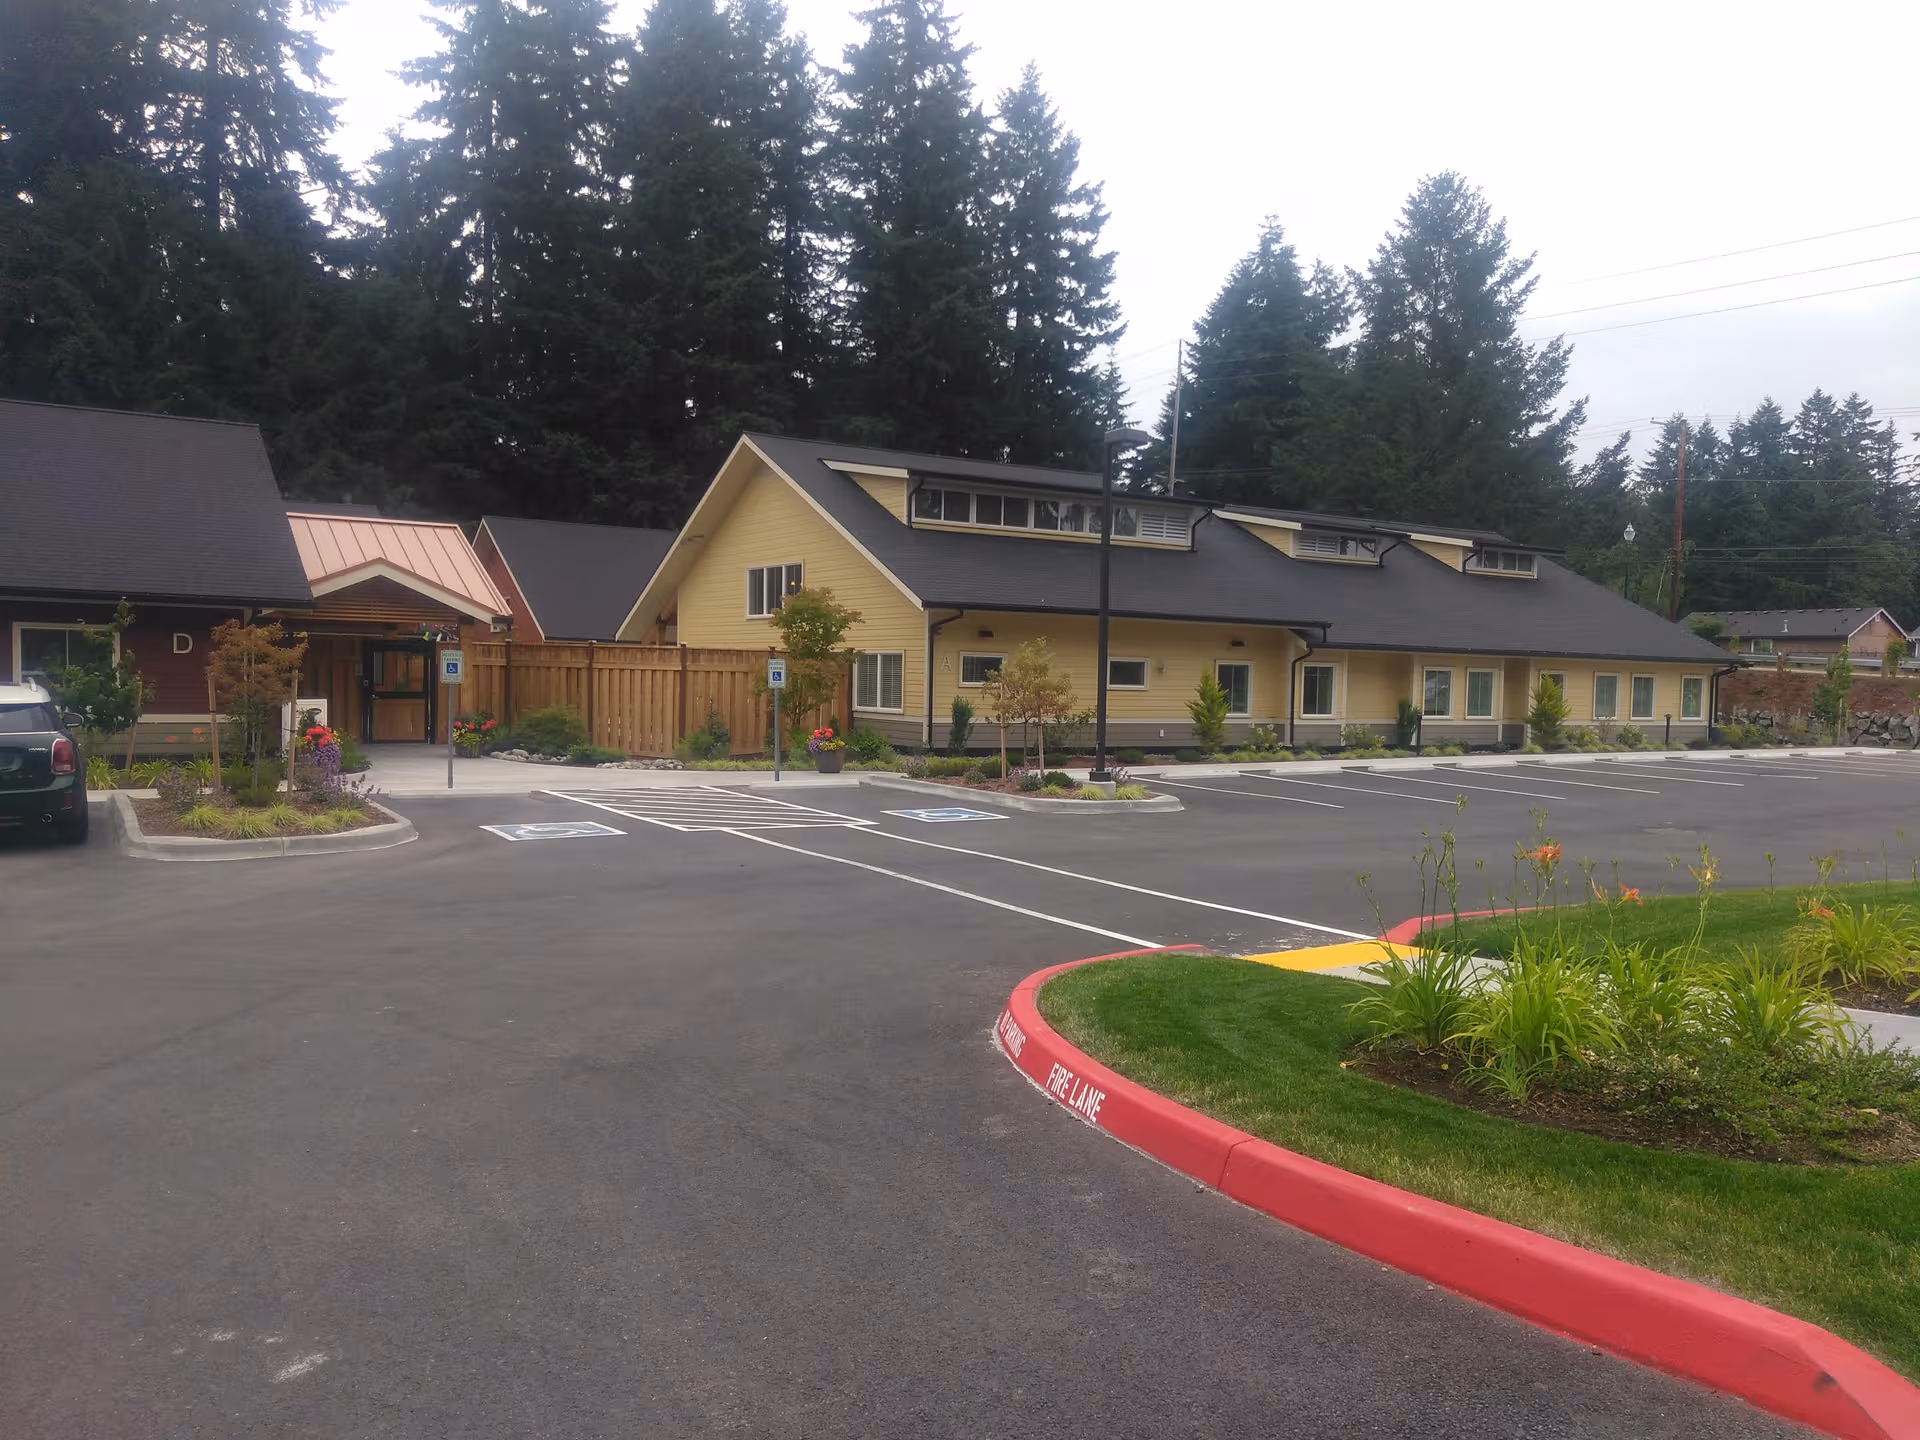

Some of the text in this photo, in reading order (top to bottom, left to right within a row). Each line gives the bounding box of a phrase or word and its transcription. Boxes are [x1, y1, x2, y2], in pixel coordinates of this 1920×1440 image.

[173, 633, 193, 654] D
[940, 656, 953, 671] A
[1045, 1061, 1106, 1123] FIRE LANE
